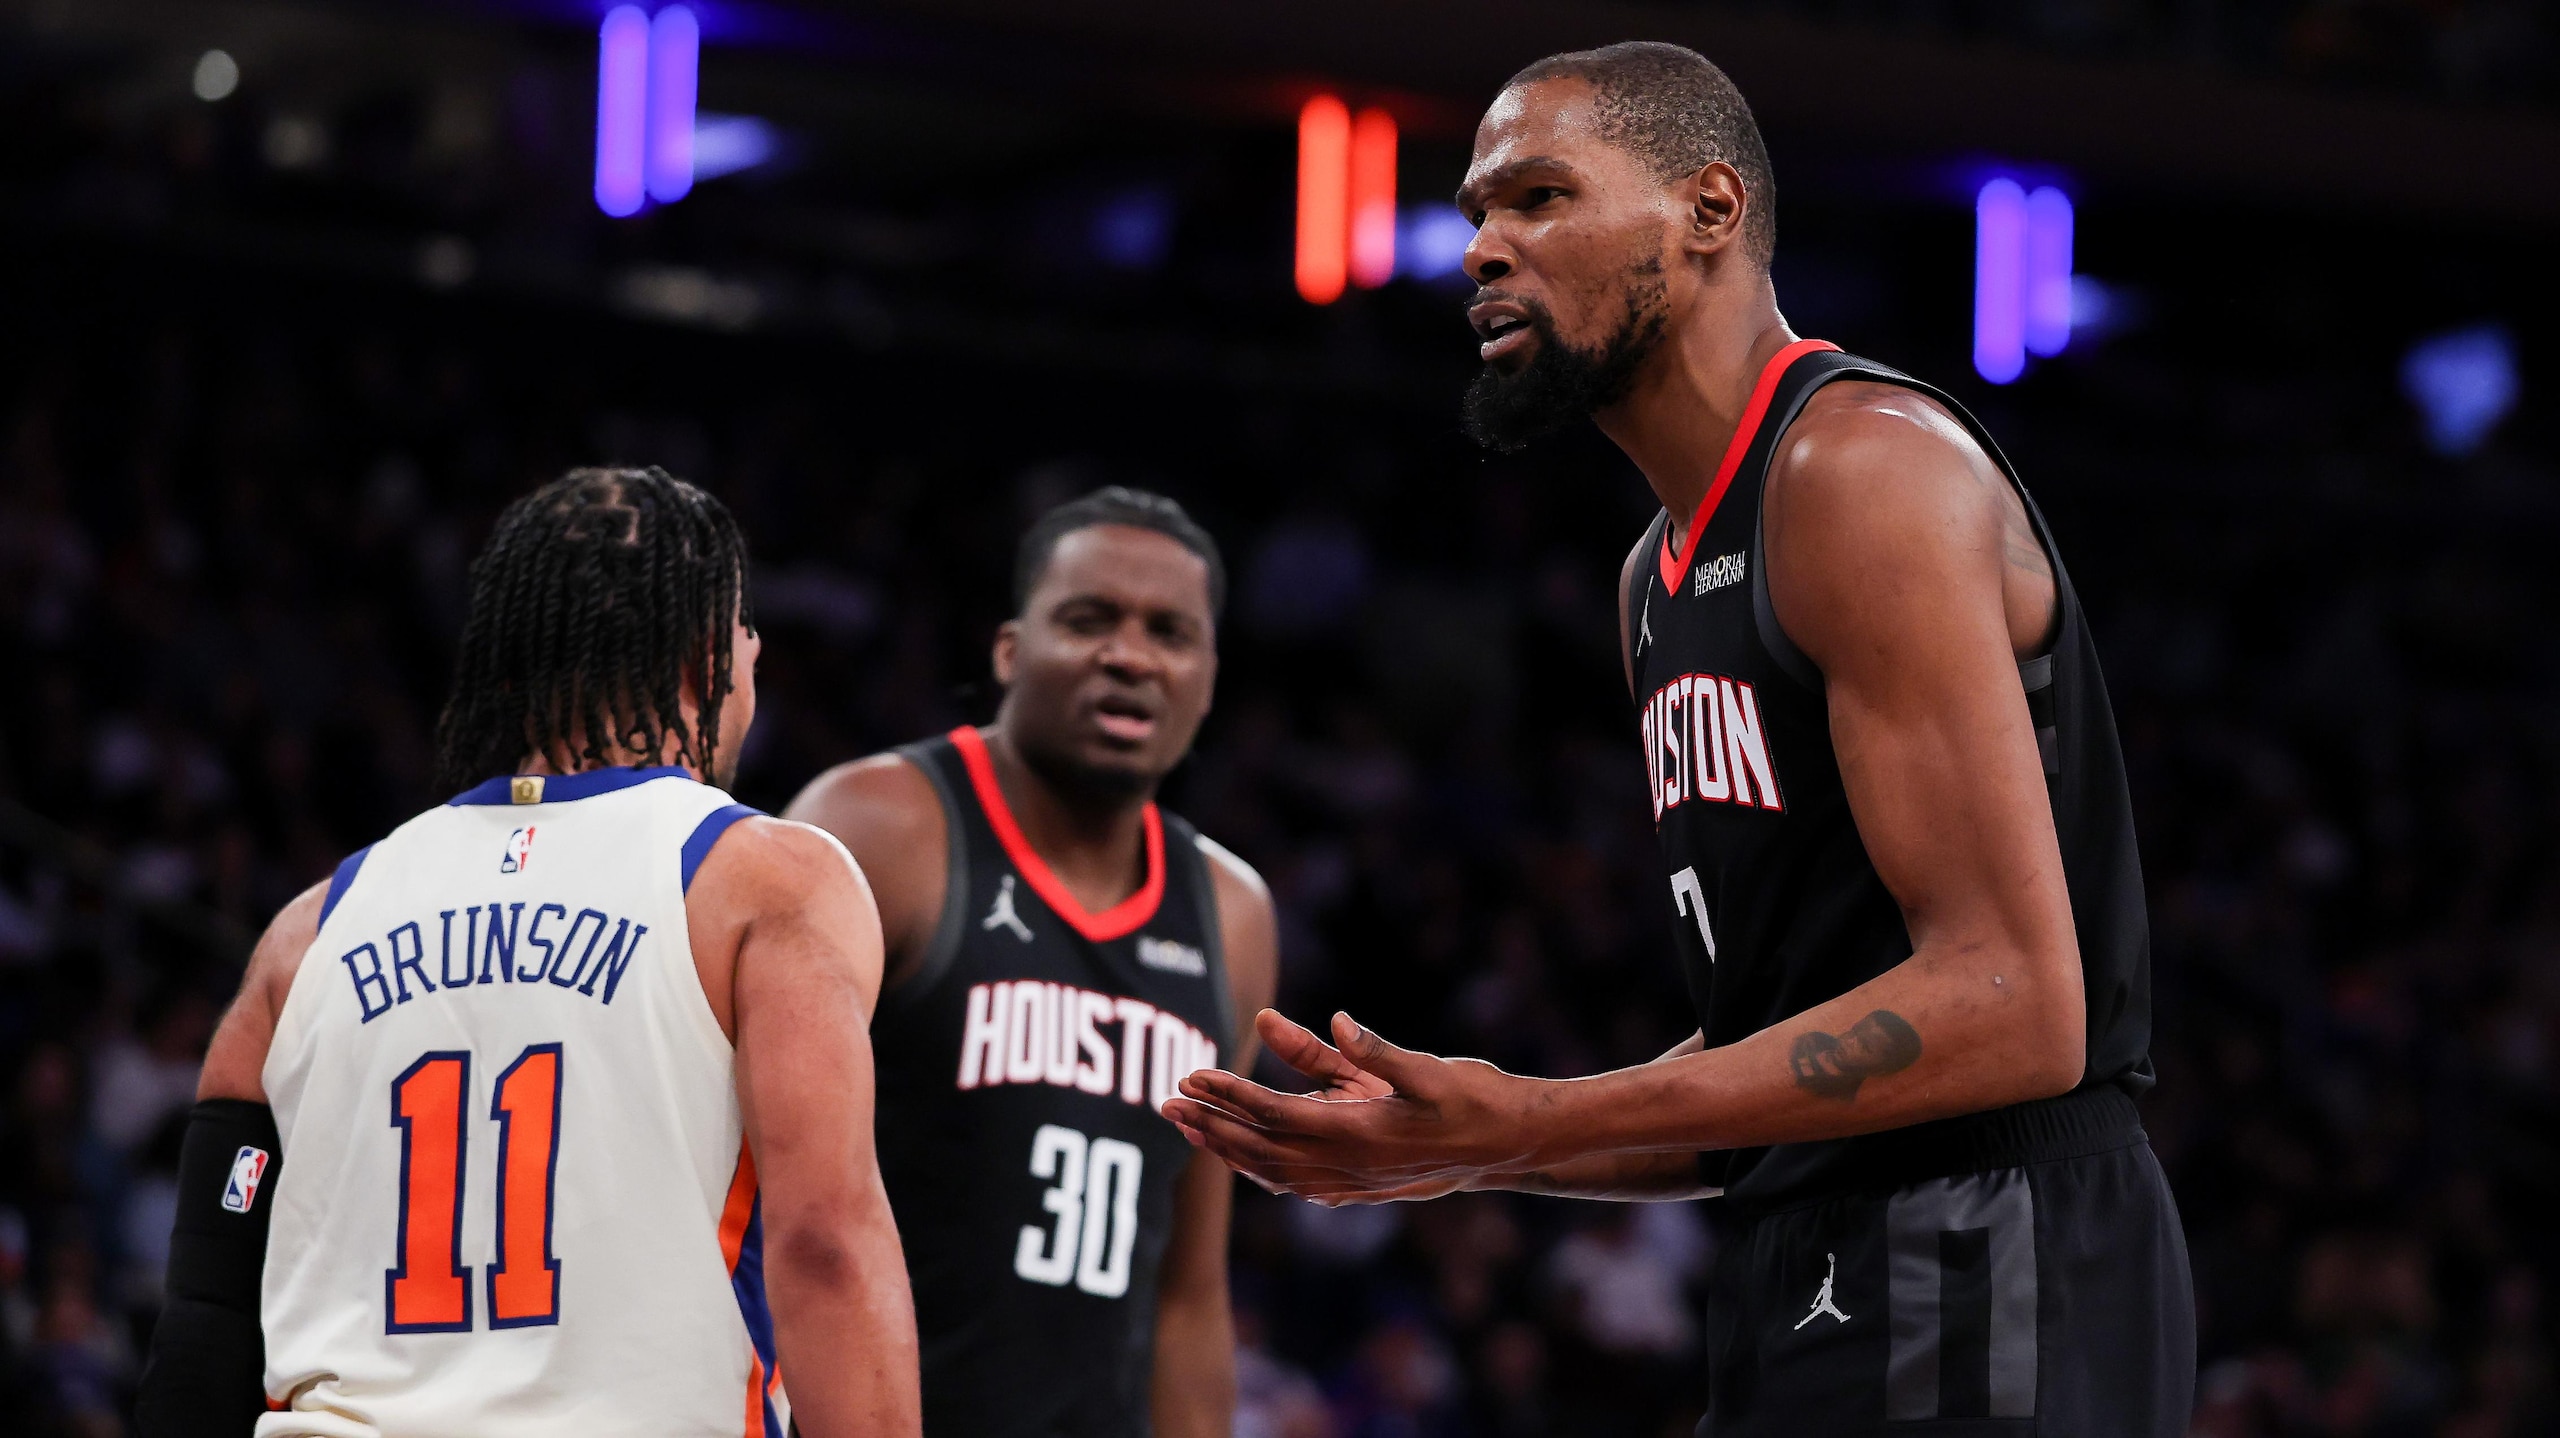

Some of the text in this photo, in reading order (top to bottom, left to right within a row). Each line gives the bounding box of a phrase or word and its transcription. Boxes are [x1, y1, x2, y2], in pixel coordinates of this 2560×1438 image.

[1695, 550, 1746, 581] MEMORIAL
[1695, 566, 1745, 597] HERMANN
[1641, 671, 1784, 824] OUSTON
[341, 903, 649, 1024] BRUNSON
[385, 1041, 563, 1335] 11
[1013, 1123, 1144, 1299] 30
